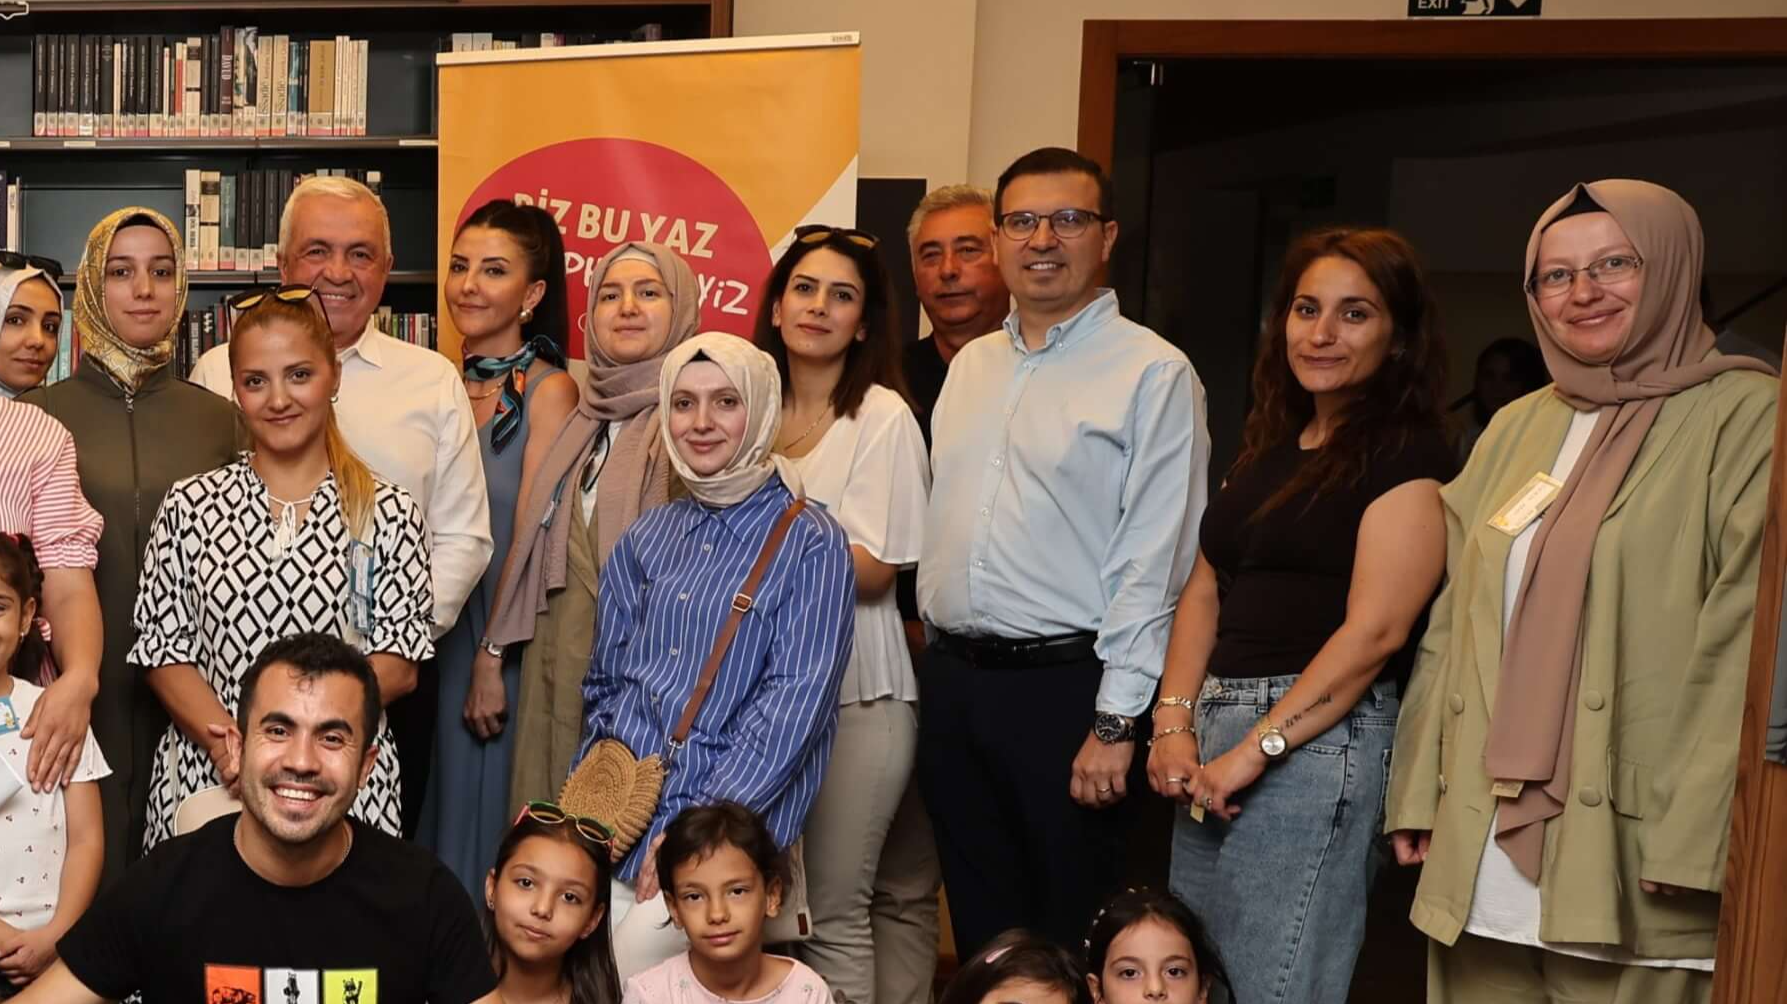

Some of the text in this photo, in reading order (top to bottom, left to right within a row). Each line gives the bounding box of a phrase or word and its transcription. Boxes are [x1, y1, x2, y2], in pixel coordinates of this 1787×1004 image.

[1417, 0, 1450, 9] EXIT
[576, 203, 632, 244] BU
[639, 211, 719, 259] YAZ
